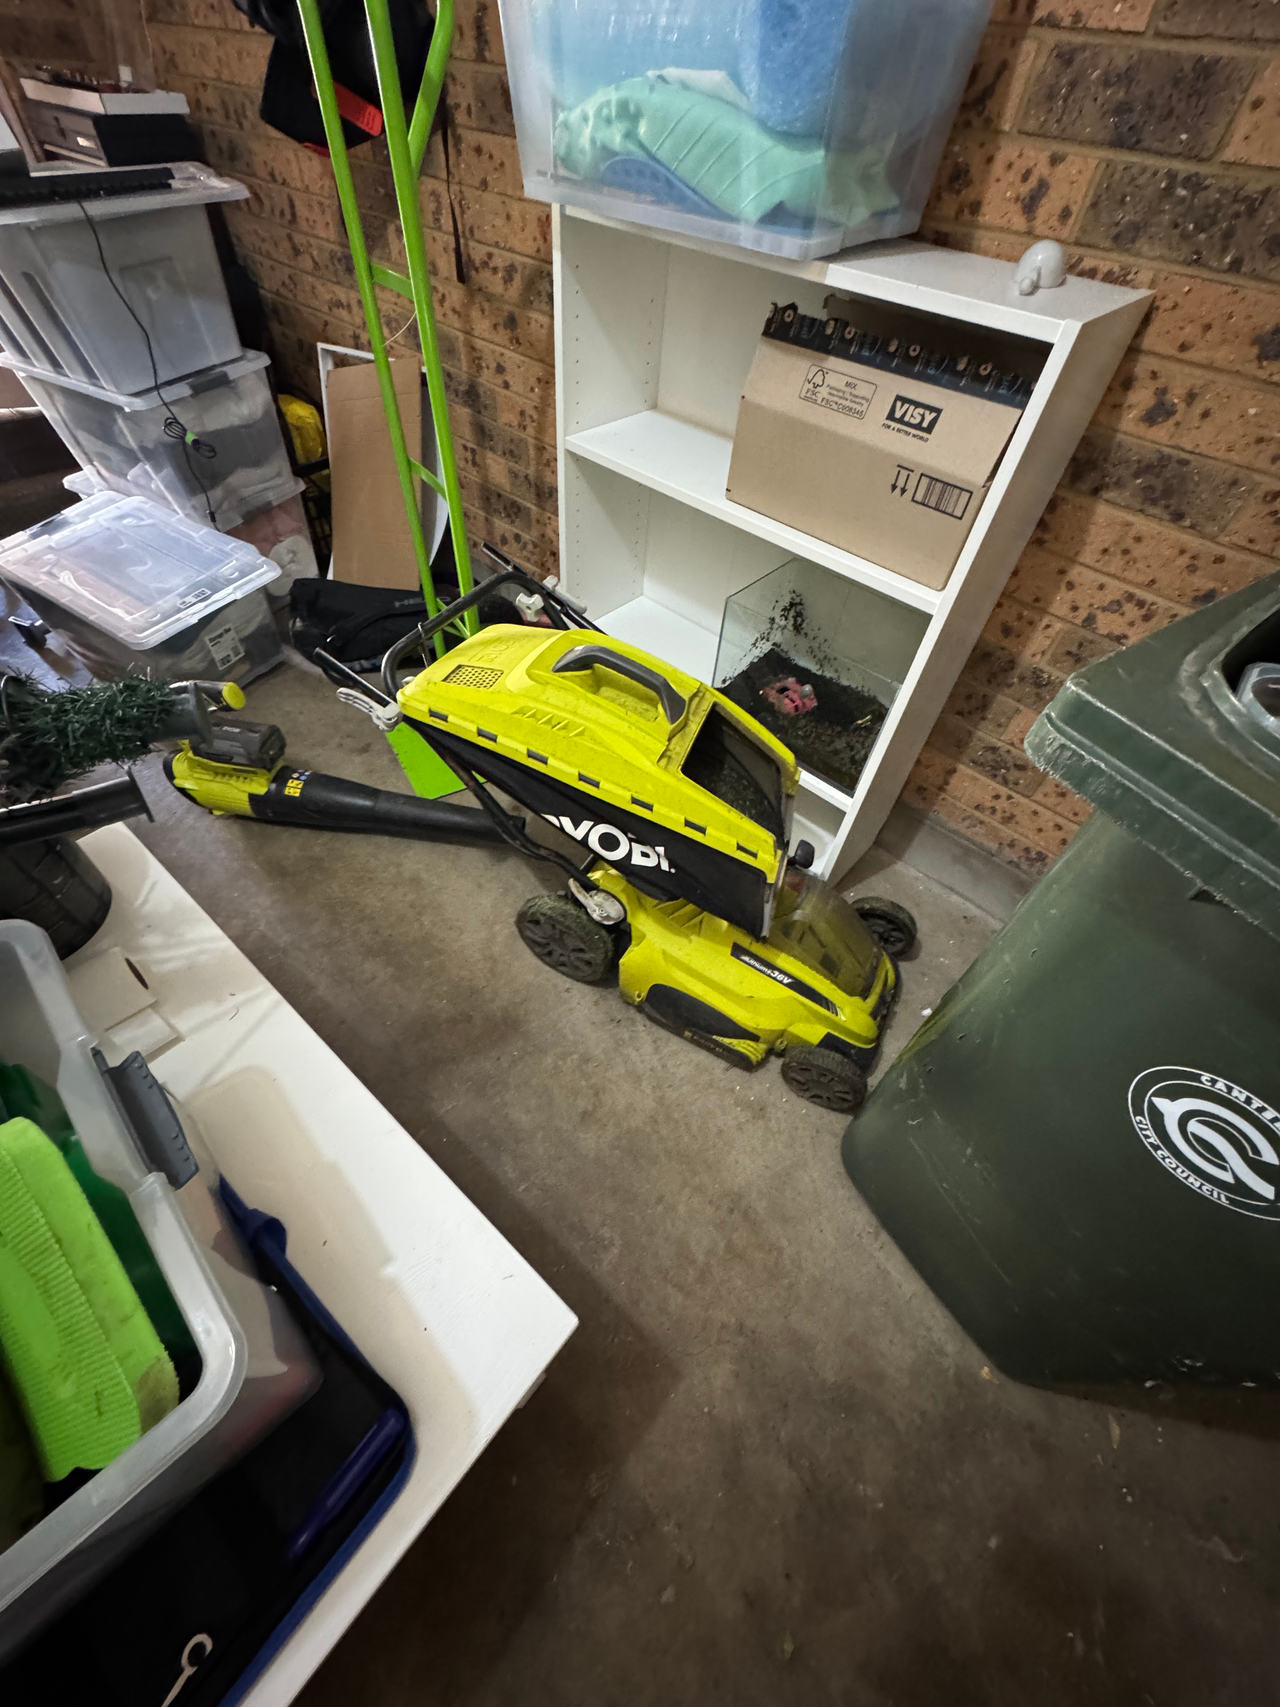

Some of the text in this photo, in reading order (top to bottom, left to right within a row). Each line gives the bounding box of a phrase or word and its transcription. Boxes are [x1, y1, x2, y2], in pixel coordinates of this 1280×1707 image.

[894, 400, 938, 428] VISY
[1135, 1116, 1230, 1204] CITY COUNCIL
